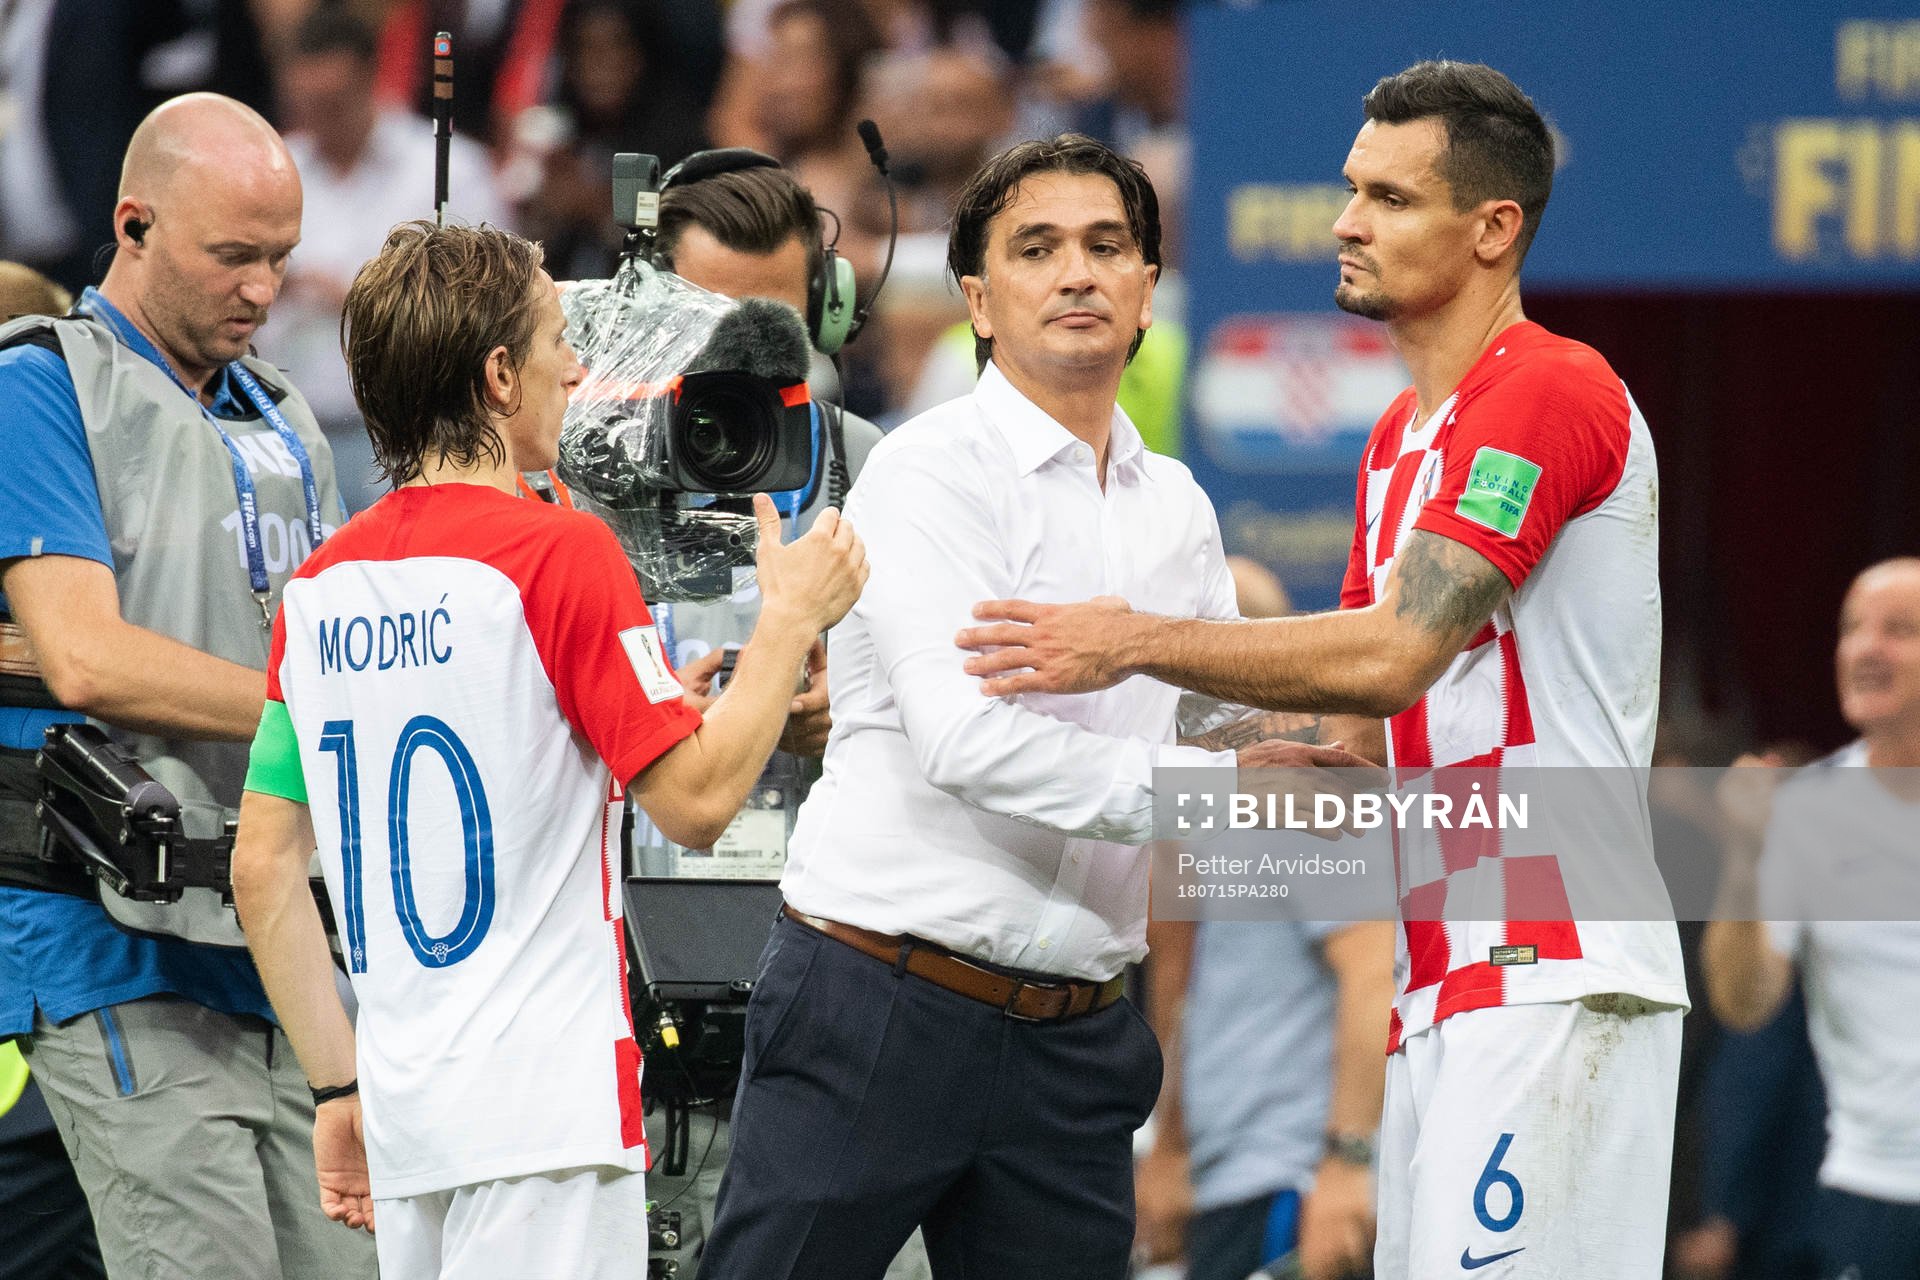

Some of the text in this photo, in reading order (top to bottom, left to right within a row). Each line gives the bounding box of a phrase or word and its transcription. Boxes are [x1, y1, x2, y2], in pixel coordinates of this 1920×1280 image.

[1475, 469, 1529, 494] LIVING
[1500, 501, 1521, 517] FIFA
[242, 492, 257, 549] FIFA.com
[310, 485, 323, 541] FIFA.com
[318, 593, 453, 676] MODRIĆ
[318, 714, 496, 974] 10
[1473, 1133, 1525, 1233] 6
